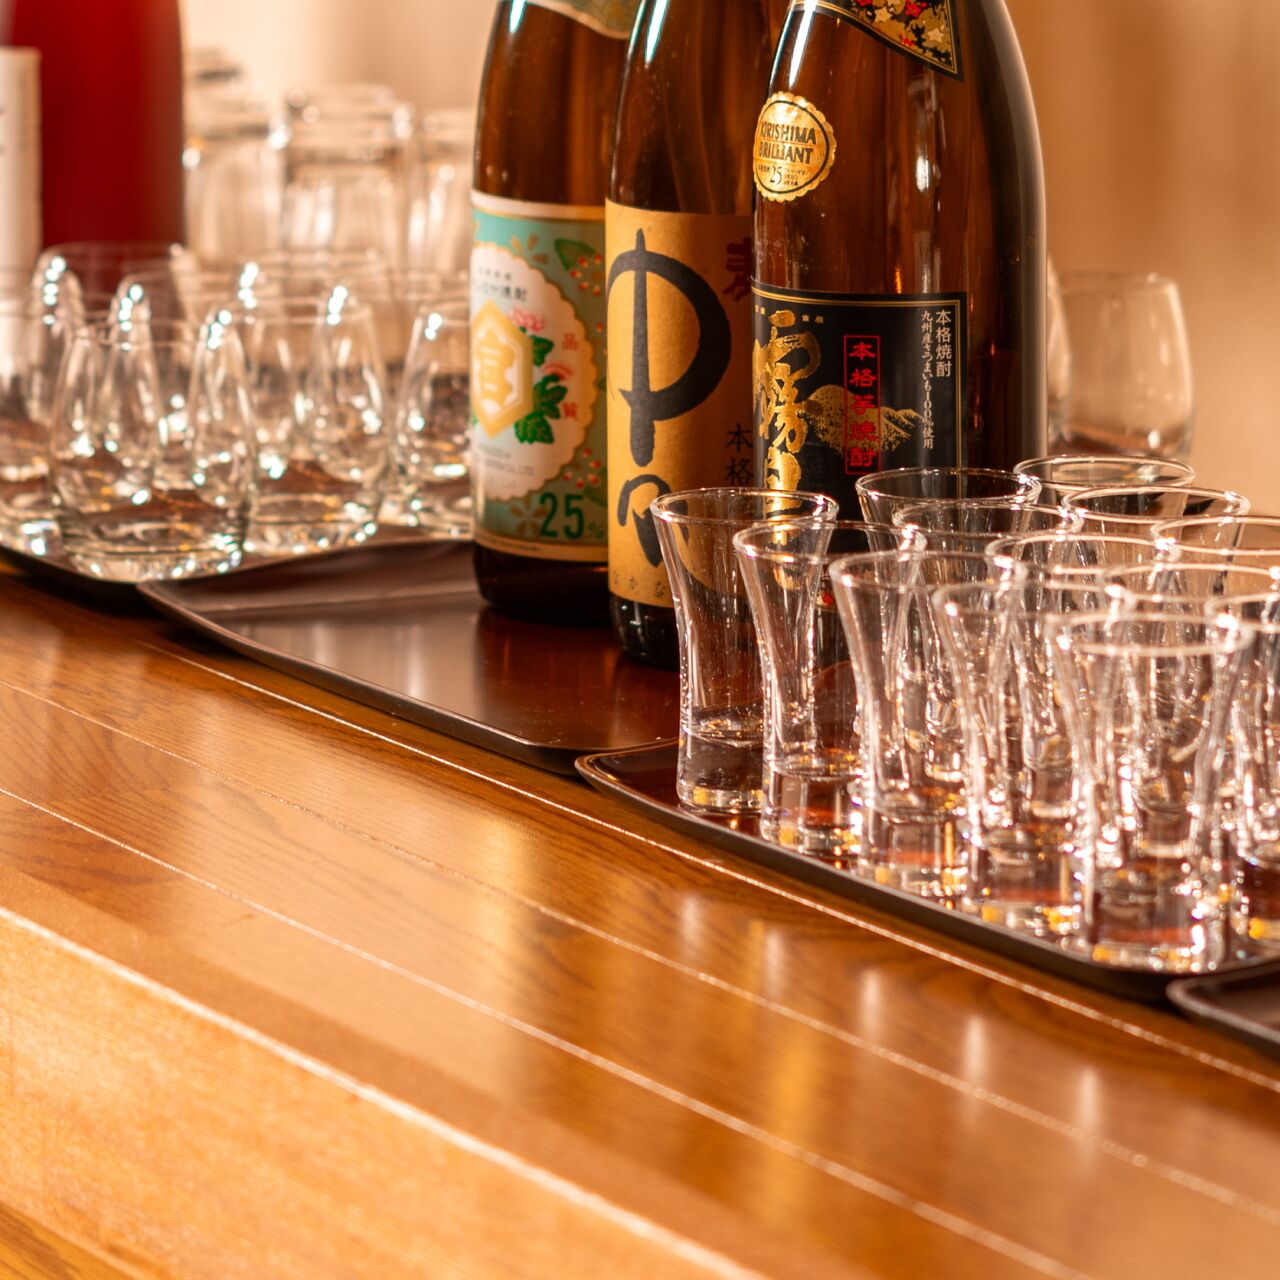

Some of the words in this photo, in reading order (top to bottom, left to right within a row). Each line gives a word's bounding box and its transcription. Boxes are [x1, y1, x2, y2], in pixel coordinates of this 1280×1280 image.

[759, 141, 813, 164] BRILLIANT
[935, 309, 953, 378] 本格焼酎
[848, 340, 877, 468] 本格芋焼酎
[539, 492, 605, 540] 25%
